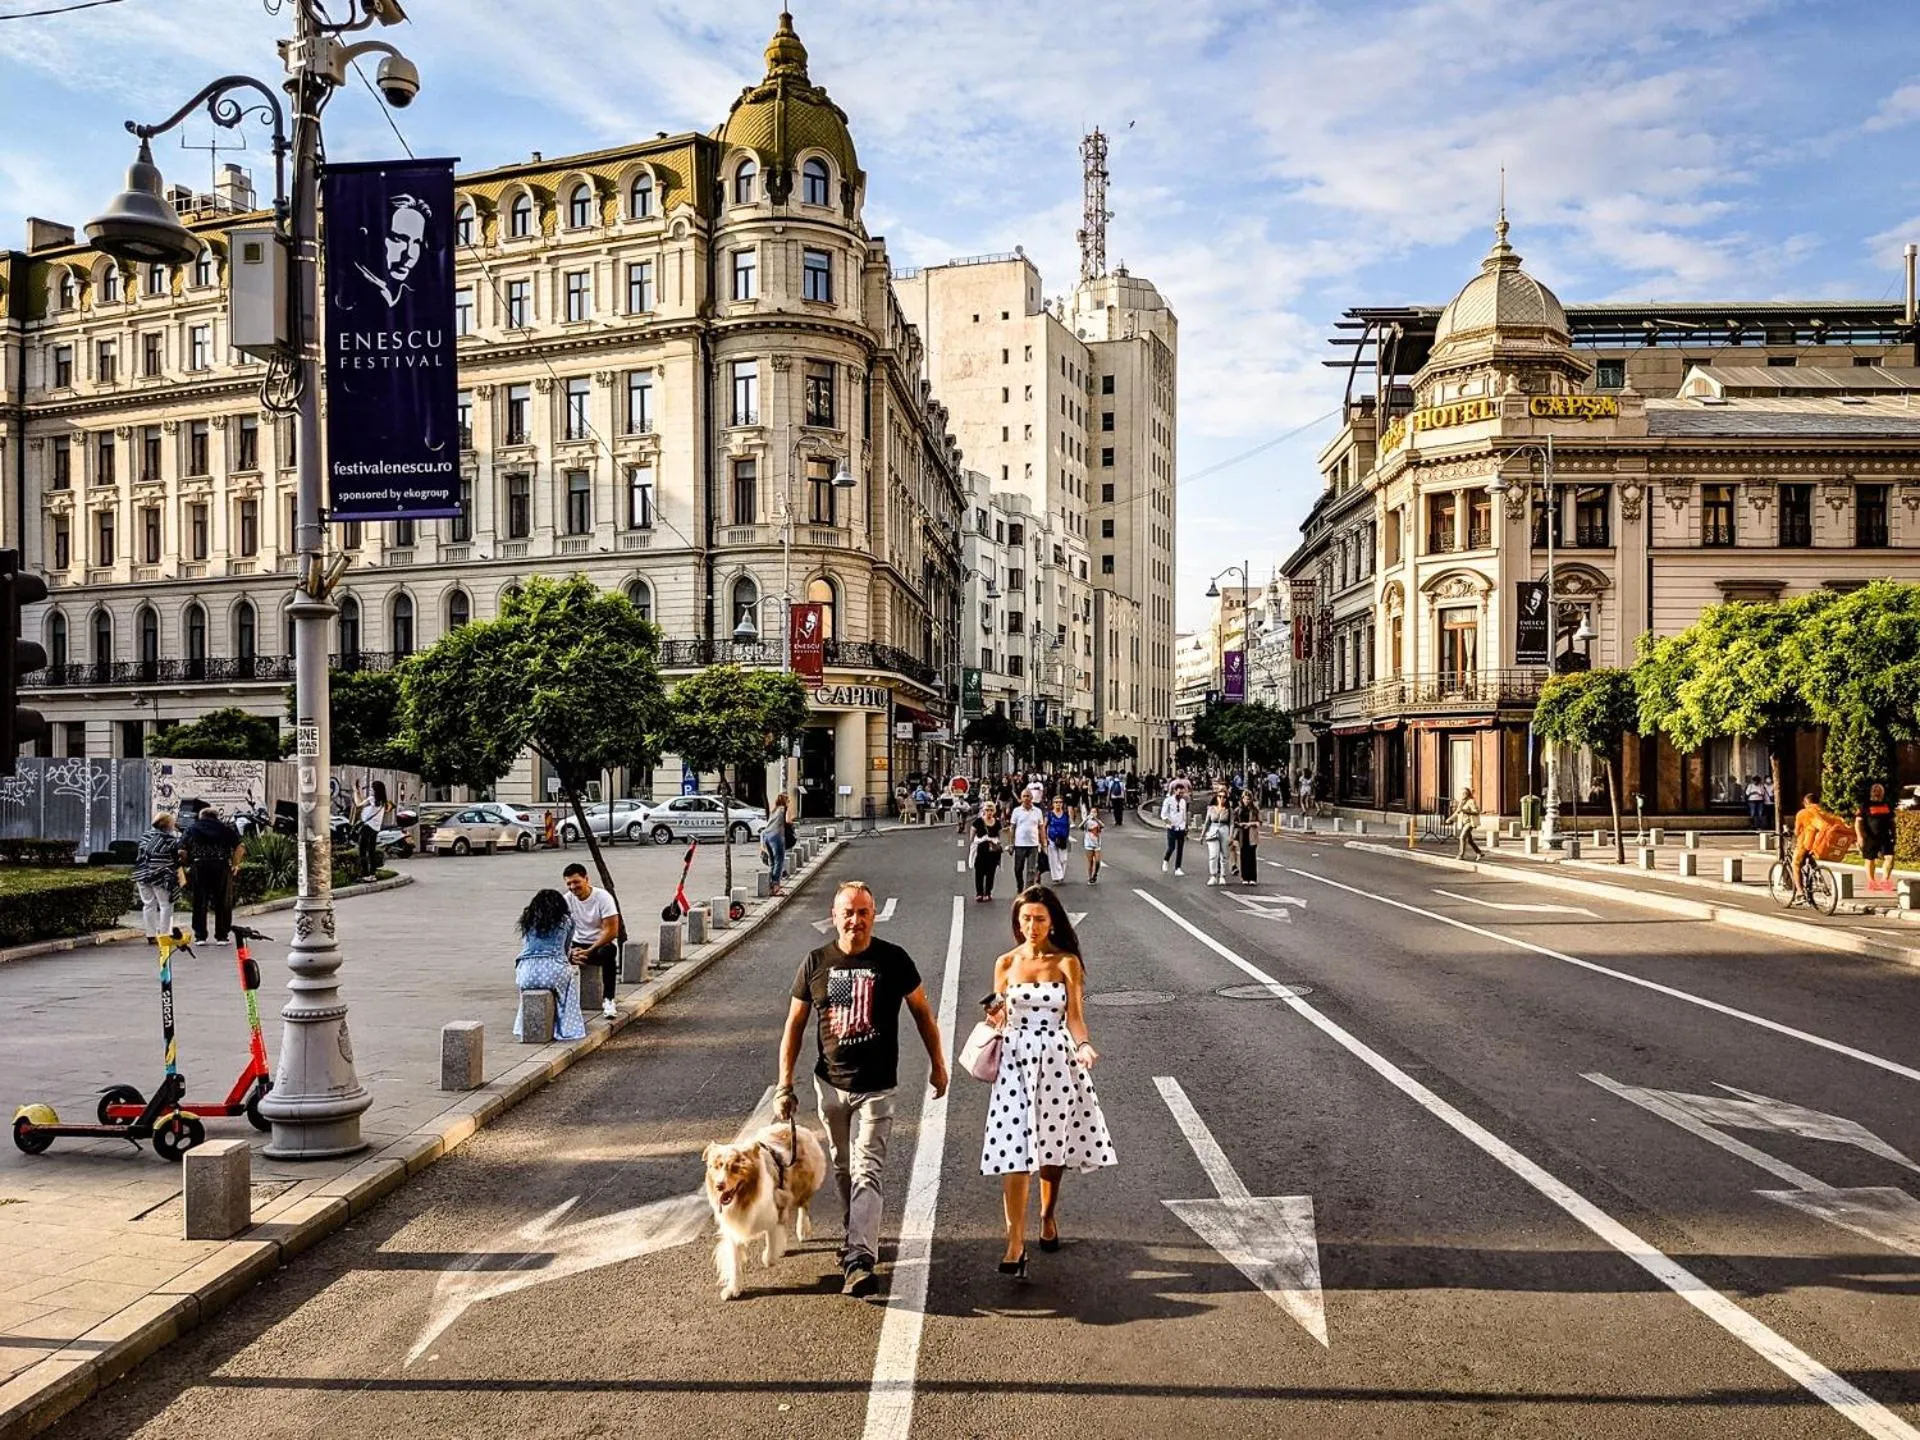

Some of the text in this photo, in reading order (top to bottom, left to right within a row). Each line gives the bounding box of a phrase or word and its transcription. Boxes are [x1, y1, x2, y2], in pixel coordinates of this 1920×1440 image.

[340, 330, 442, 350] ENESCU
[340, 354, 443, 369] FESTIVAL
[1417, 400, 1495, 430] HOTEL
[334, 460, 453, 475] festivalenescu.ro
[338, 488, 449, 502] sponsored by ekogroup
[815, 684, 889, 708] CAPITO
[829, 967, 874, 978] NEW YORK
